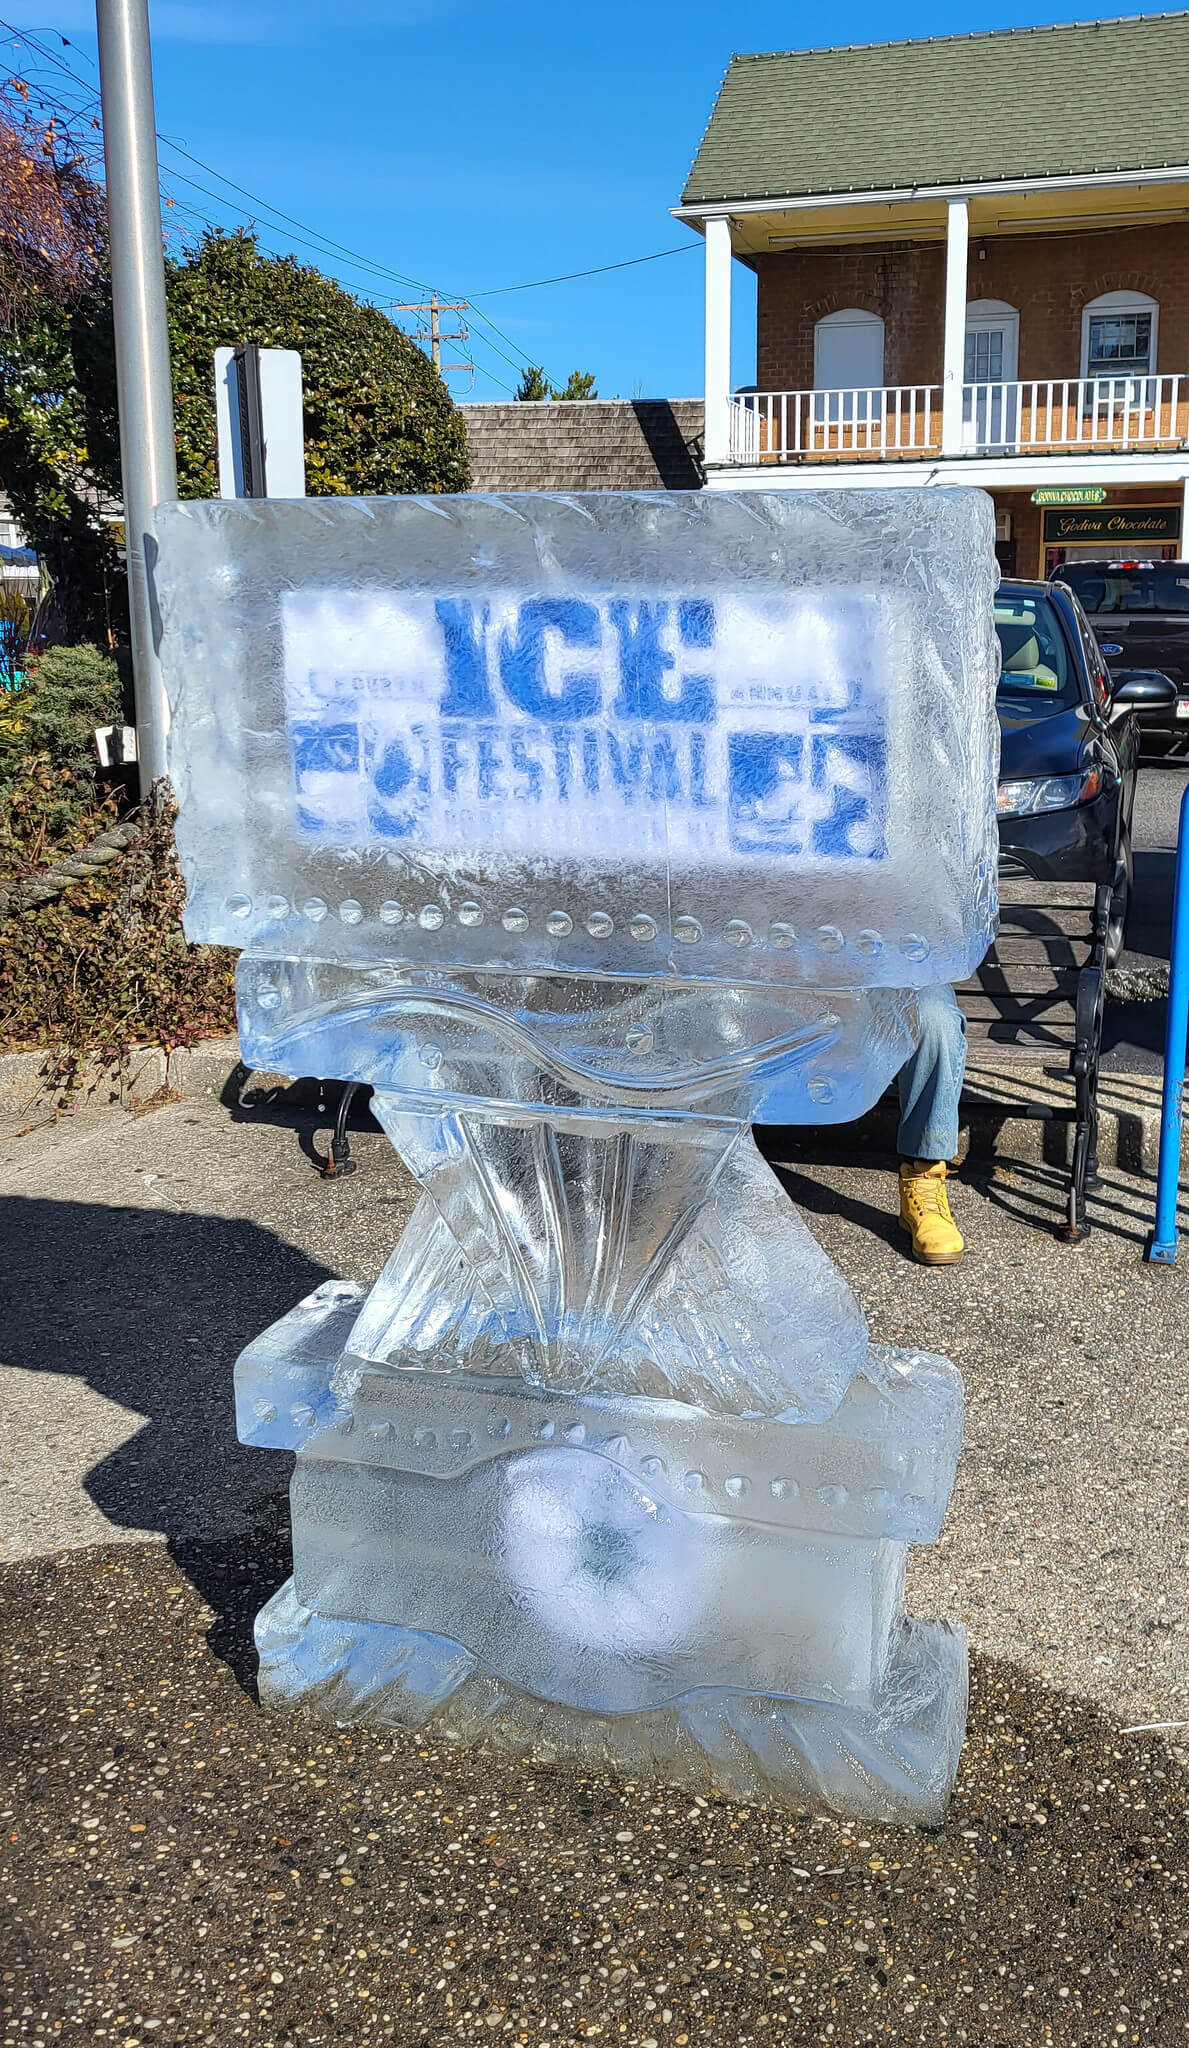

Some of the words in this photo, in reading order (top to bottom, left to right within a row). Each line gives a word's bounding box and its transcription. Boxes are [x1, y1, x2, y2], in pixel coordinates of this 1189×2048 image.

[1057, 517, 1102, 536] Godiva
[1107, 516, 1167, 531] Chocolate
[435, 599, 717, 719] ICE
[439, 723, 718, 807] FESTIVAL
